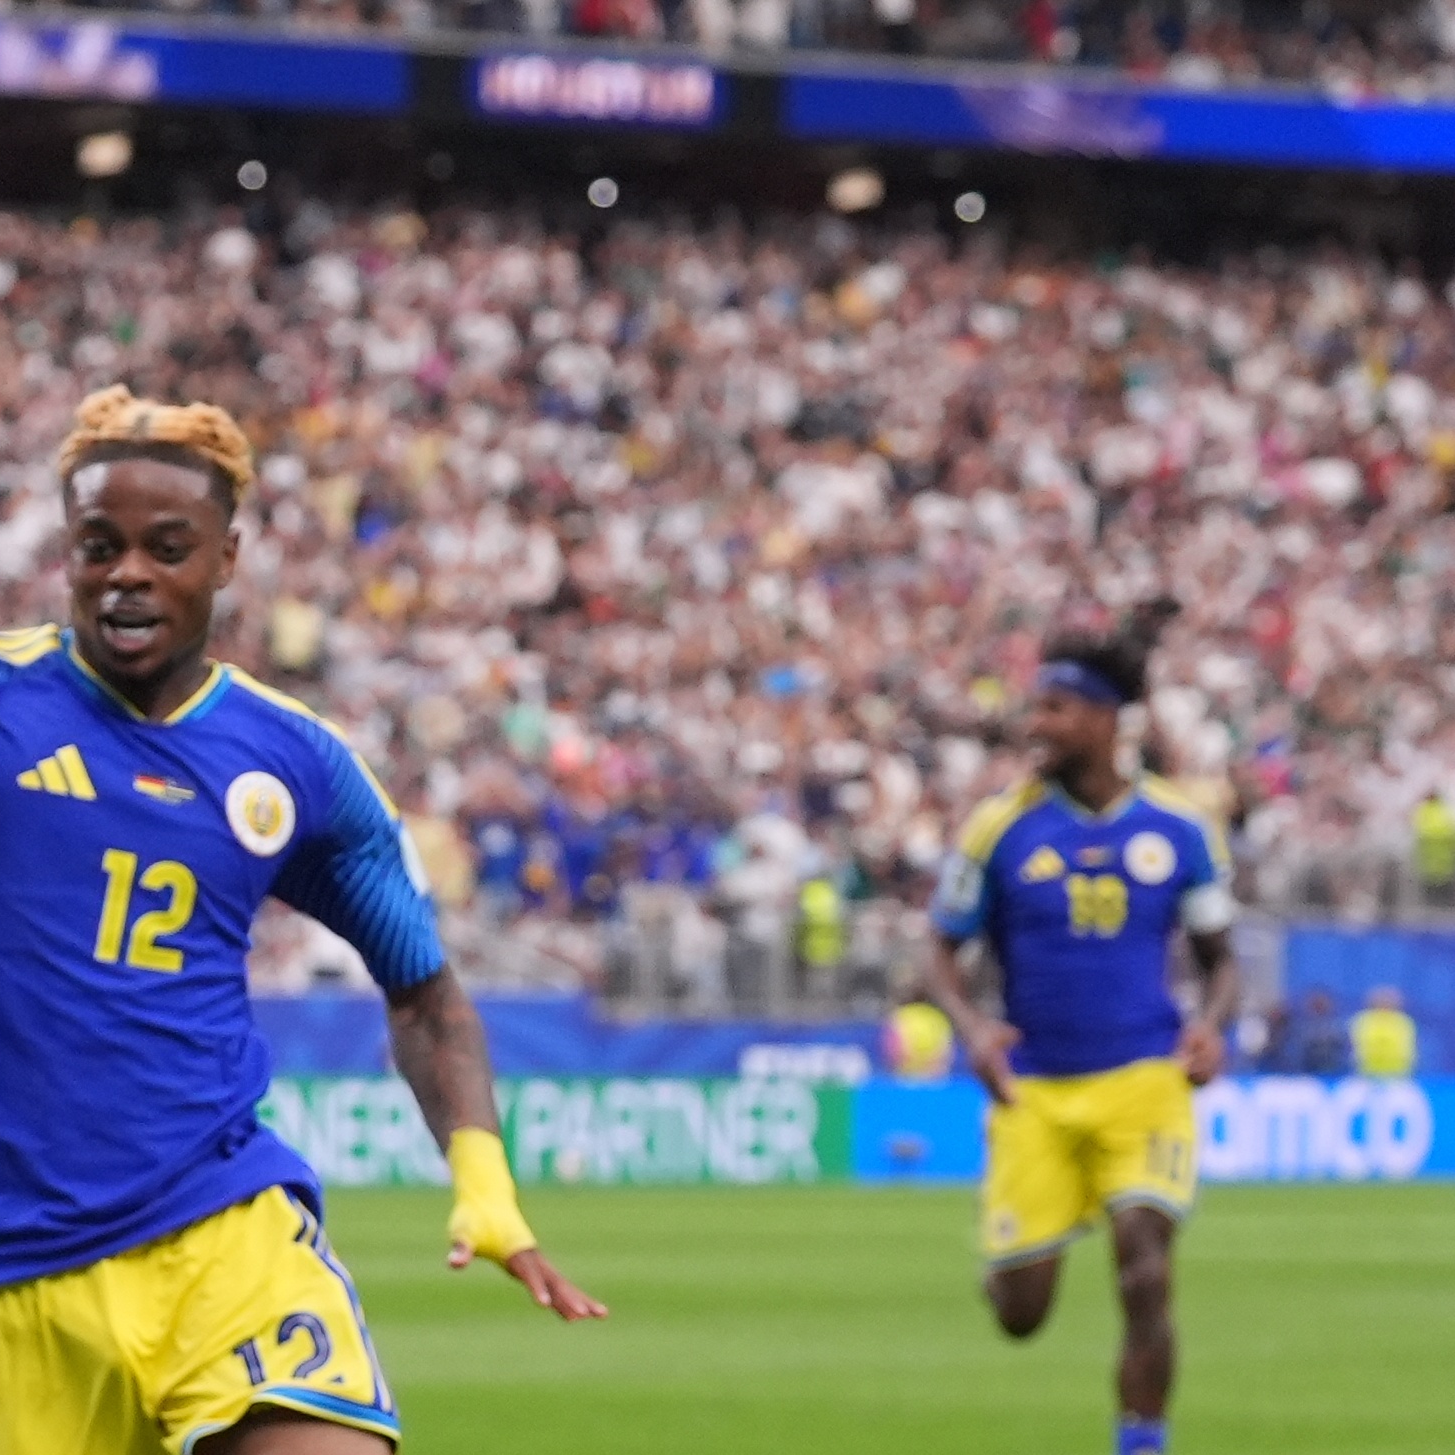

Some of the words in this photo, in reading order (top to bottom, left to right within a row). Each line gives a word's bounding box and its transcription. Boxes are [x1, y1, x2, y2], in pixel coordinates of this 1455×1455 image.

[94, 849, 197, 973] 12
[518, 1078, 818, 1185] PARTNER
[233, 1313, 345, 1386] 12
